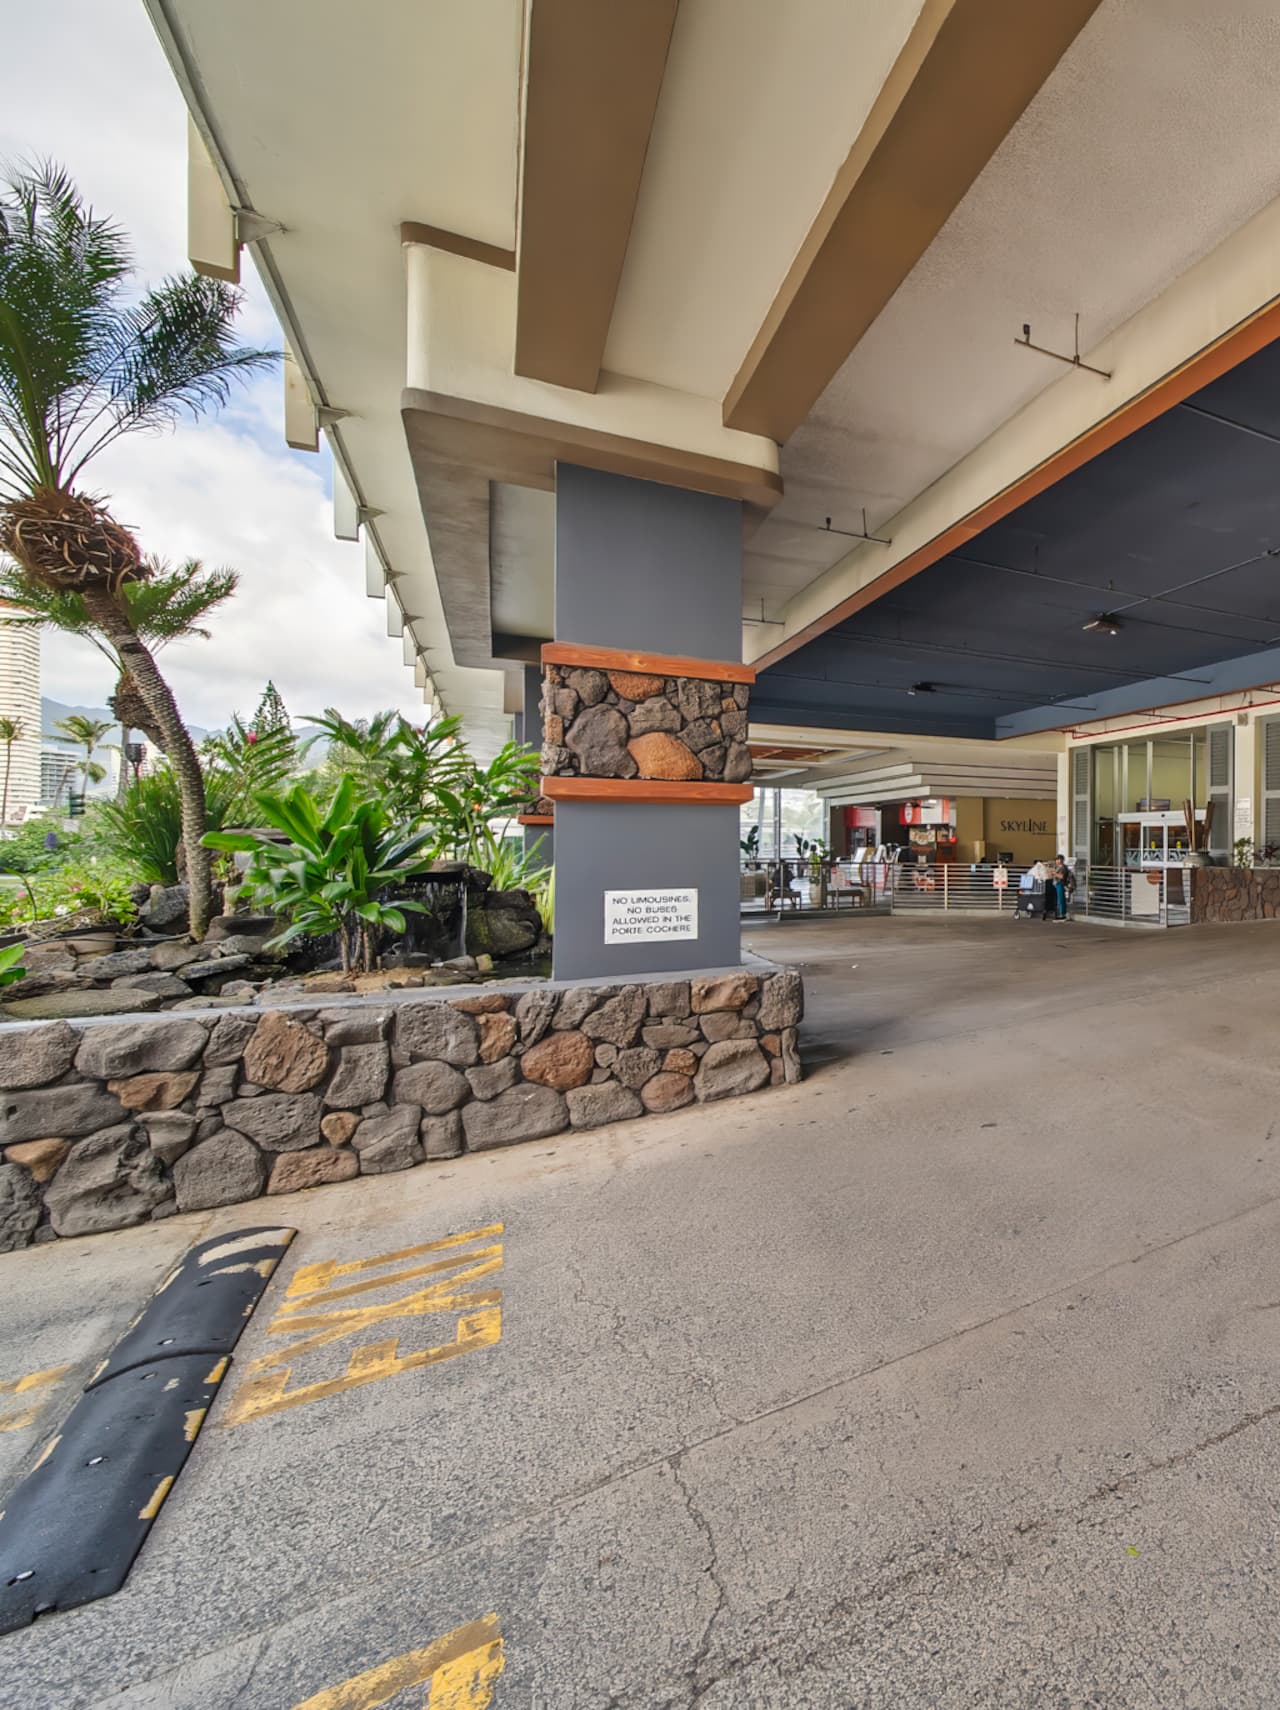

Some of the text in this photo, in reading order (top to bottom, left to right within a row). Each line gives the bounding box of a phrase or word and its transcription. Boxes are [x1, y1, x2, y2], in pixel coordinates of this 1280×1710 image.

[1000, 818, 1048, 832] SKYLINE
[612, 895, 689, 905] NO LIMOUSINES
[626, 905, 678, 915] NO BUSES
[612, 916, 659, 925] ALLOWED
[675, 914, 692, 922] THE
[611, 925, 691, 936] PORTE COCHERE
[222, 1222, 505, 1429] EXIT
